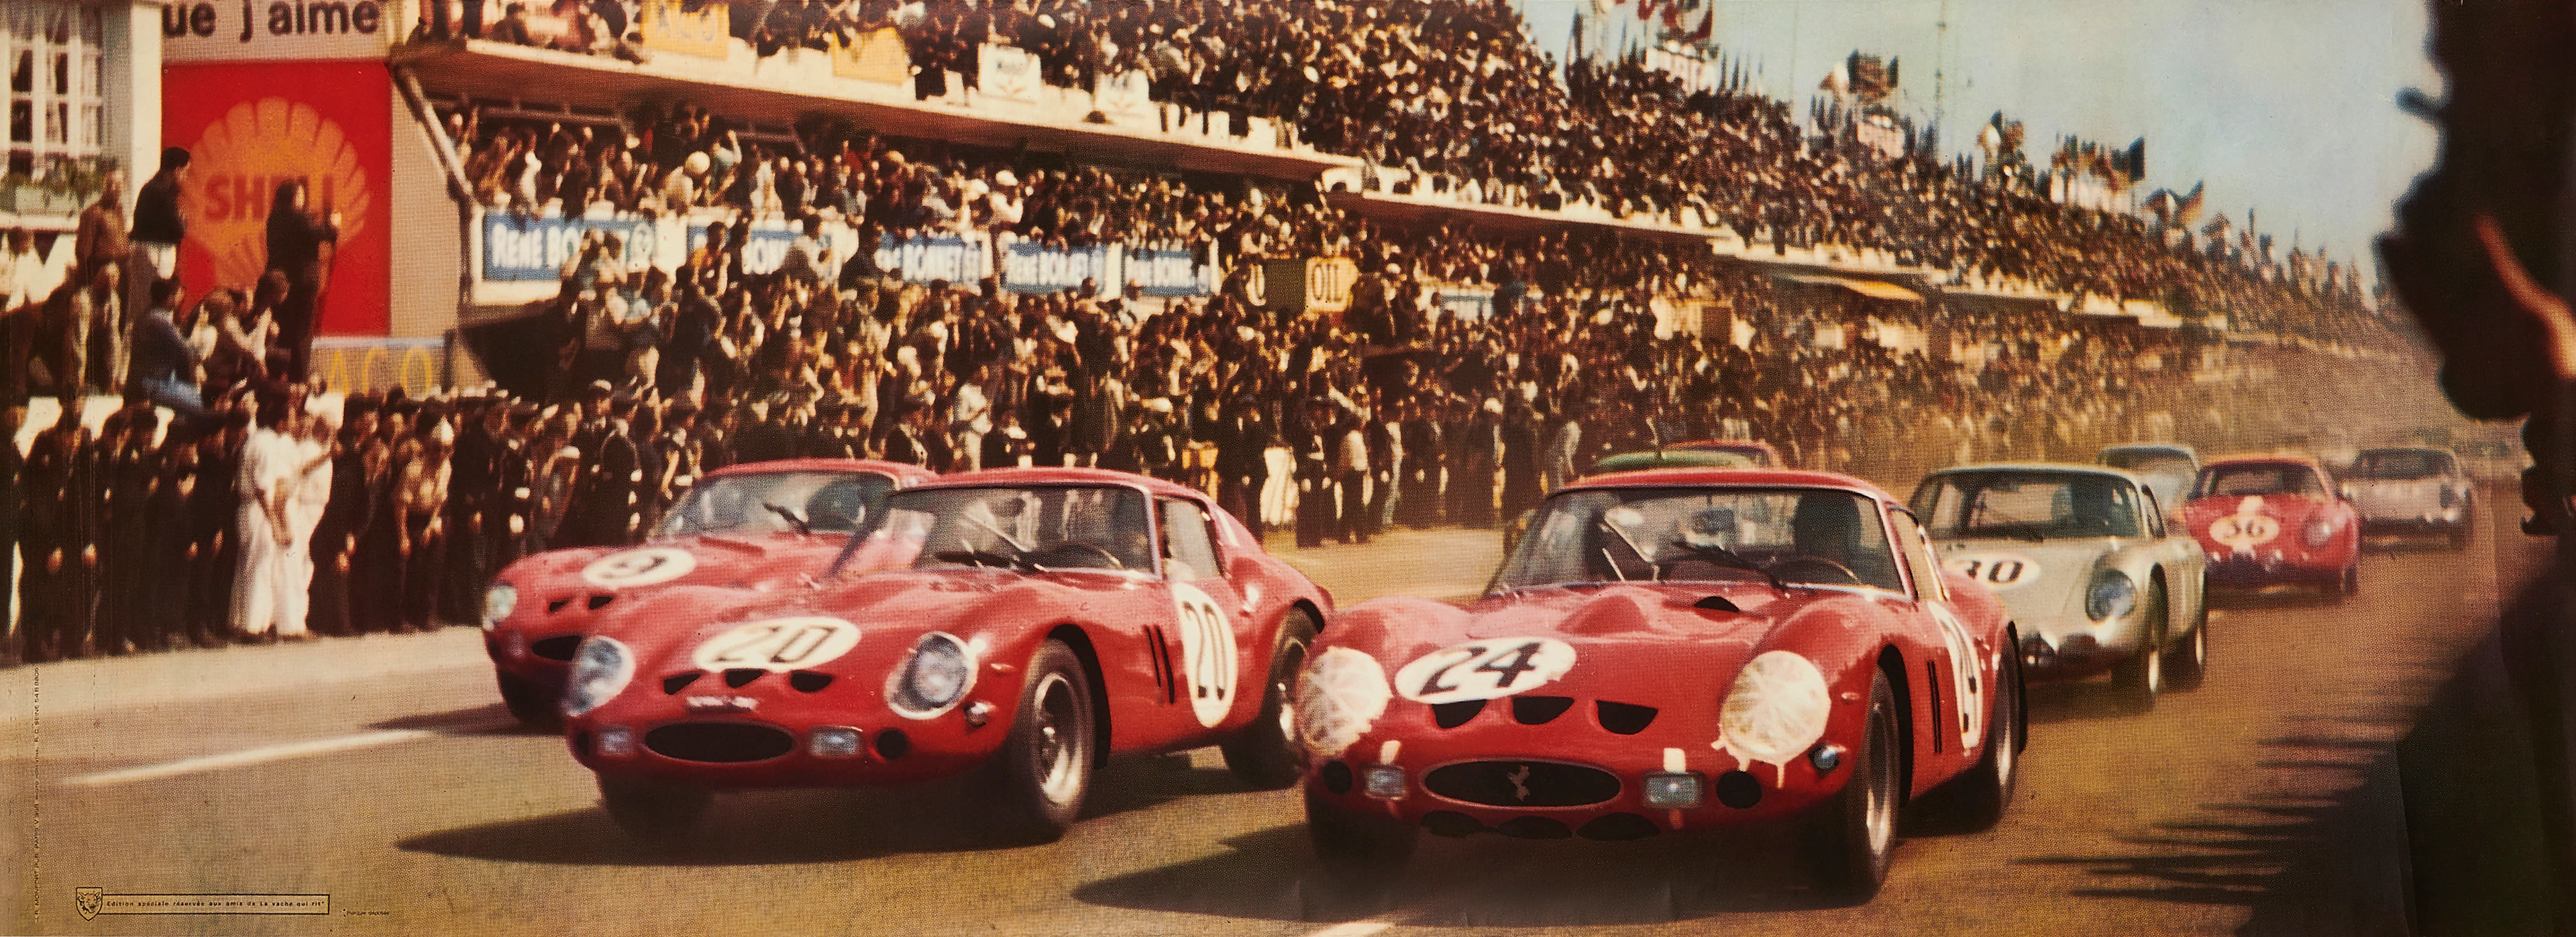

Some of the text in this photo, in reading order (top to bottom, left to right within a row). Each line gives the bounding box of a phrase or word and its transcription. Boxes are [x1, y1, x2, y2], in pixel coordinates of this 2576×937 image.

[1311, 263, 1342, 302] OIL
[711, 625, 840, 664] 20
[1183, 601, 1228, 701] 20
[1418, 642, 1542, 696] 24
